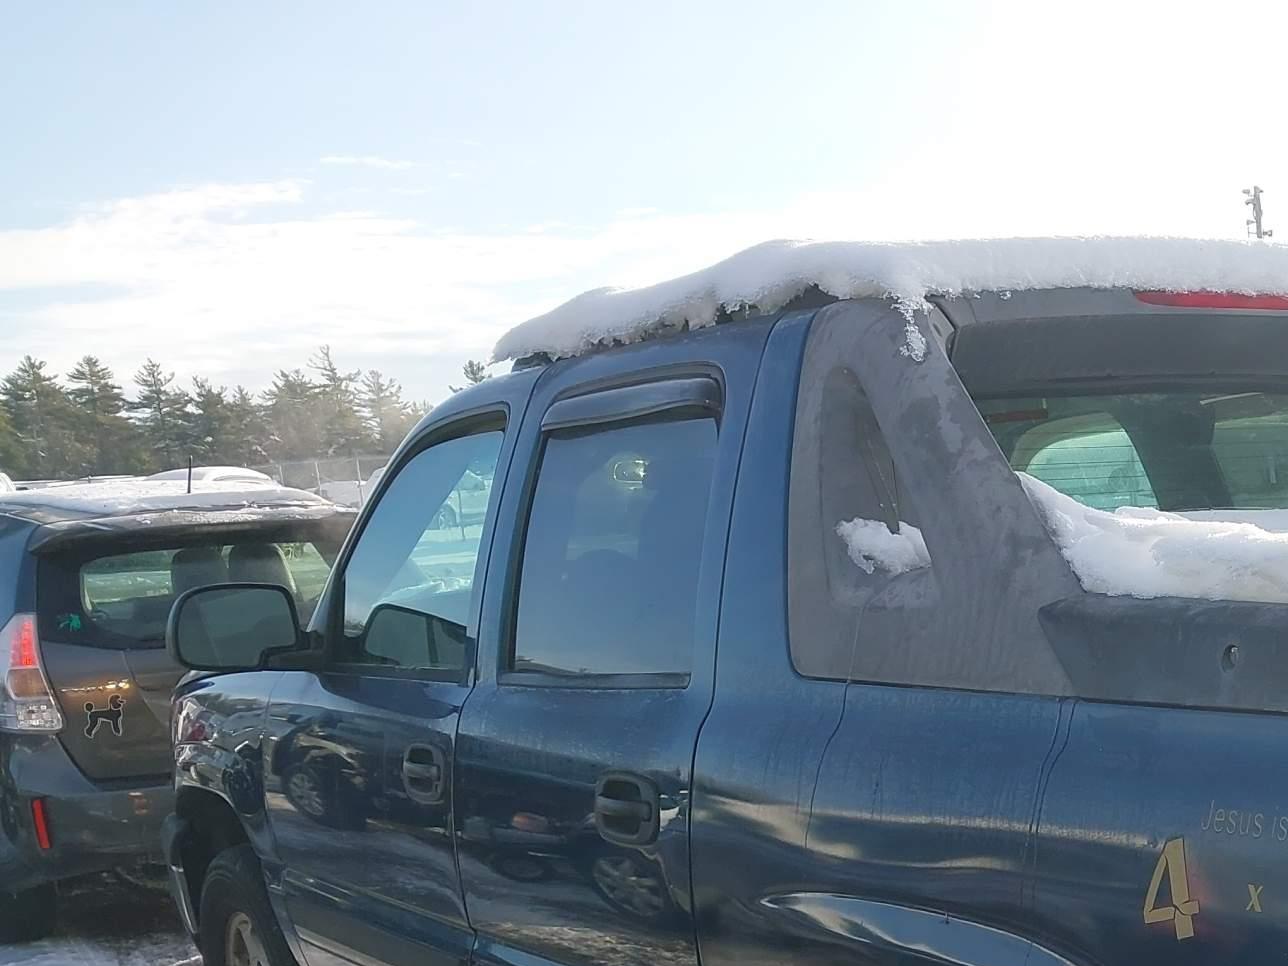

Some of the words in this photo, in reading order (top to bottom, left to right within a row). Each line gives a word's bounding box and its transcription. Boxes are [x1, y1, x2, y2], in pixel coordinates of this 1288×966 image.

[1202, 800, 1264, 838] Jesus
[1271, 806, 1288, 841] is
[1144, 836, 1199, 940] 4
